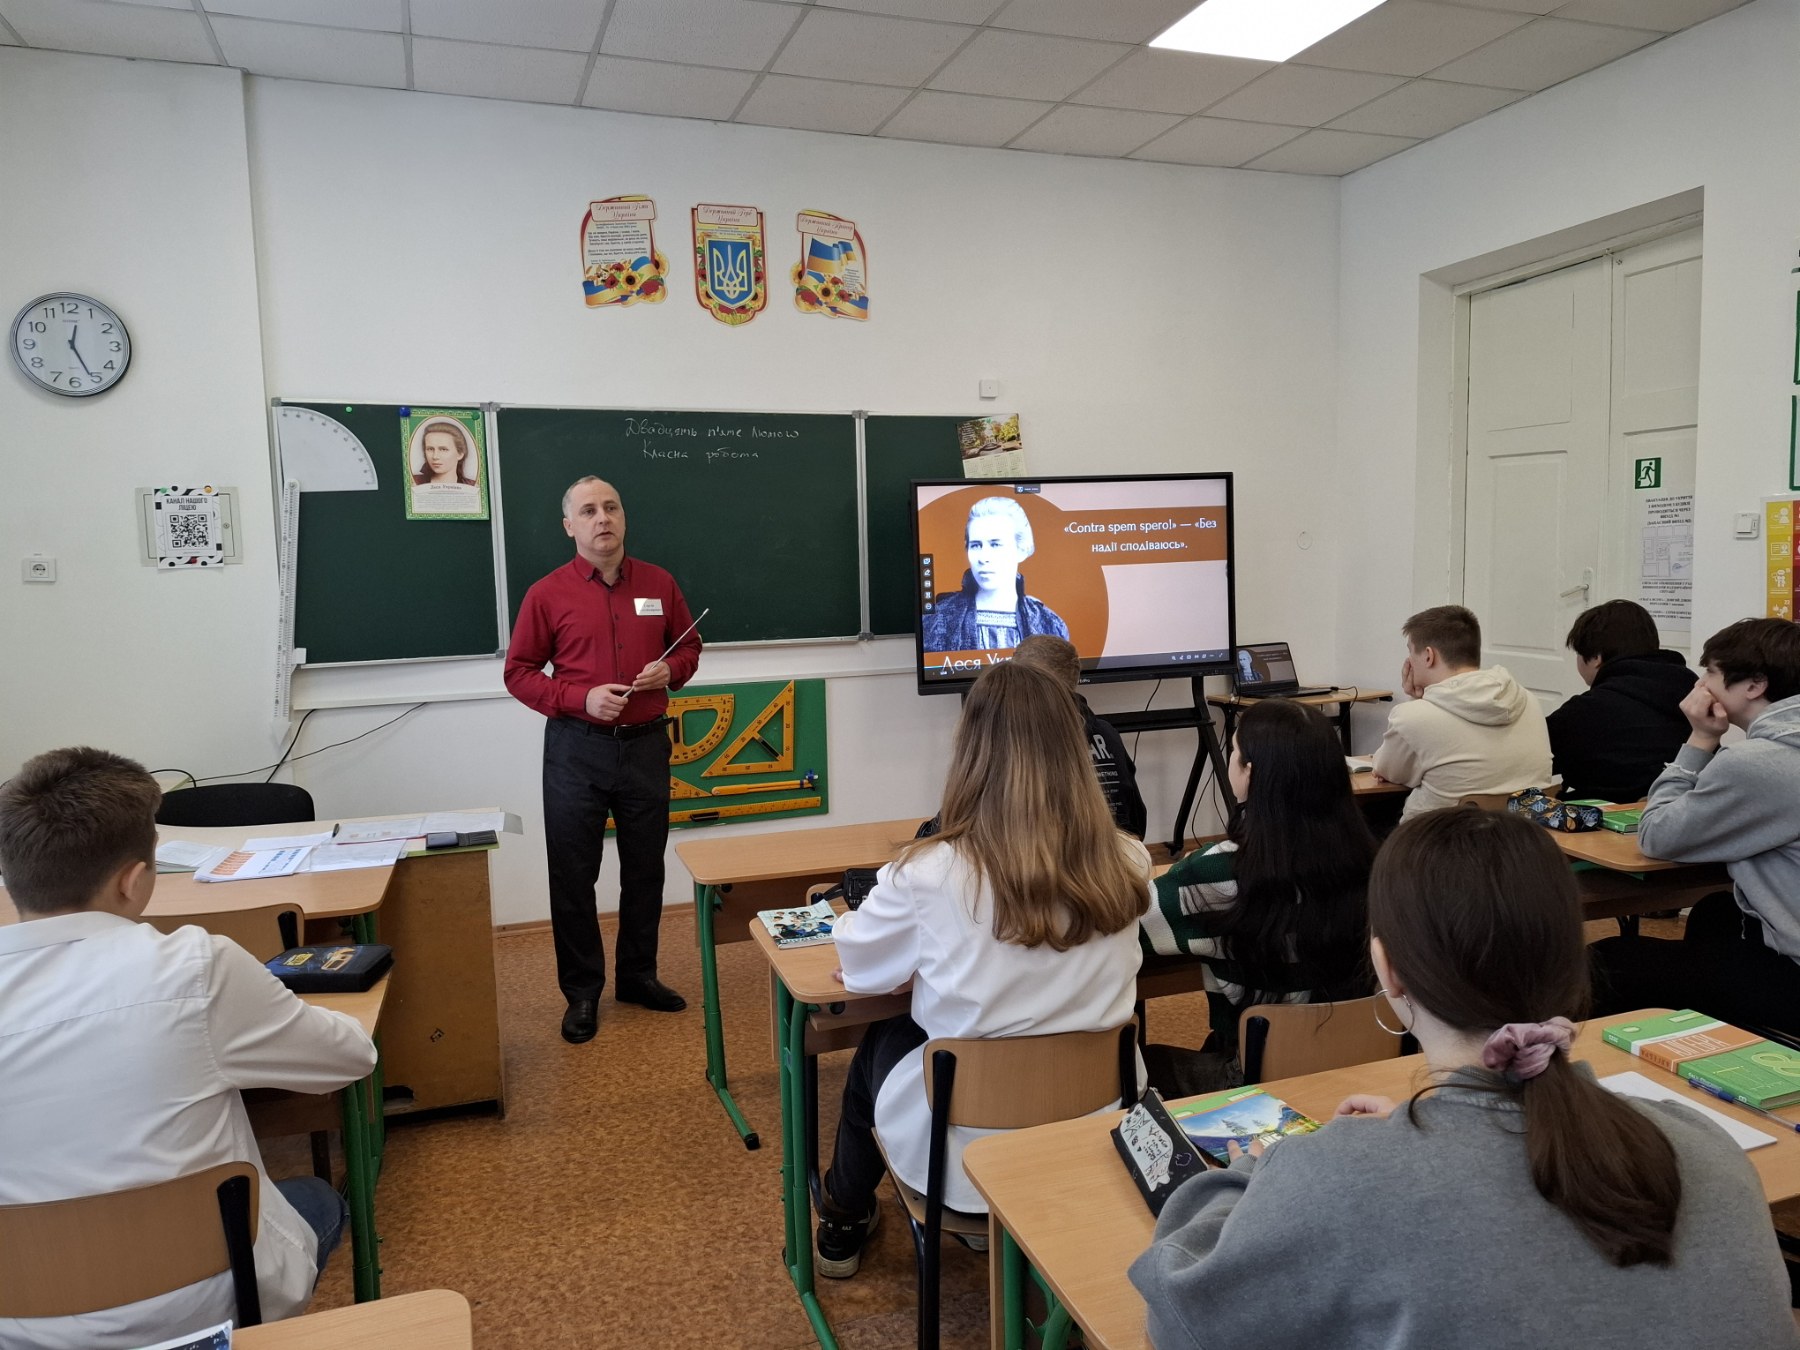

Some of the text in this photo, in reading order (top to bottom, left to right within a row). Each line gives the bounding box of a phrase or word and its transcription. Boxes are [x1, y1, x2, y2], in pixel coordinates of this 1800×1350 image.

[43, 307, 56, 319] 11
[59, 301, 80, 315] 12
[87, 307, 94, 320] 1
[28, 321, 47, 334] 10
[100, 322, 114, 335] 2
[22, 338, 36, 350] 9
[108, 340, 122, 353] 3
[30, 356, 44, 369] 8
[103, 359, 116, 371] 4
[49, 370, 63, 383] 7
[68, 376, 82, 389] 6
[90, 371, 103, 384] 5
[1064, 521, 1105, 534] «Contra
[1108, 522, 1137, 535] spem
[1139, 518, 1177, 534] spero!»
[1194, 517, 1217, 529] «Без
[1091, 540, 1188, 553] надії сподіваюсь».
[942, 655, 981, 675] Леся
